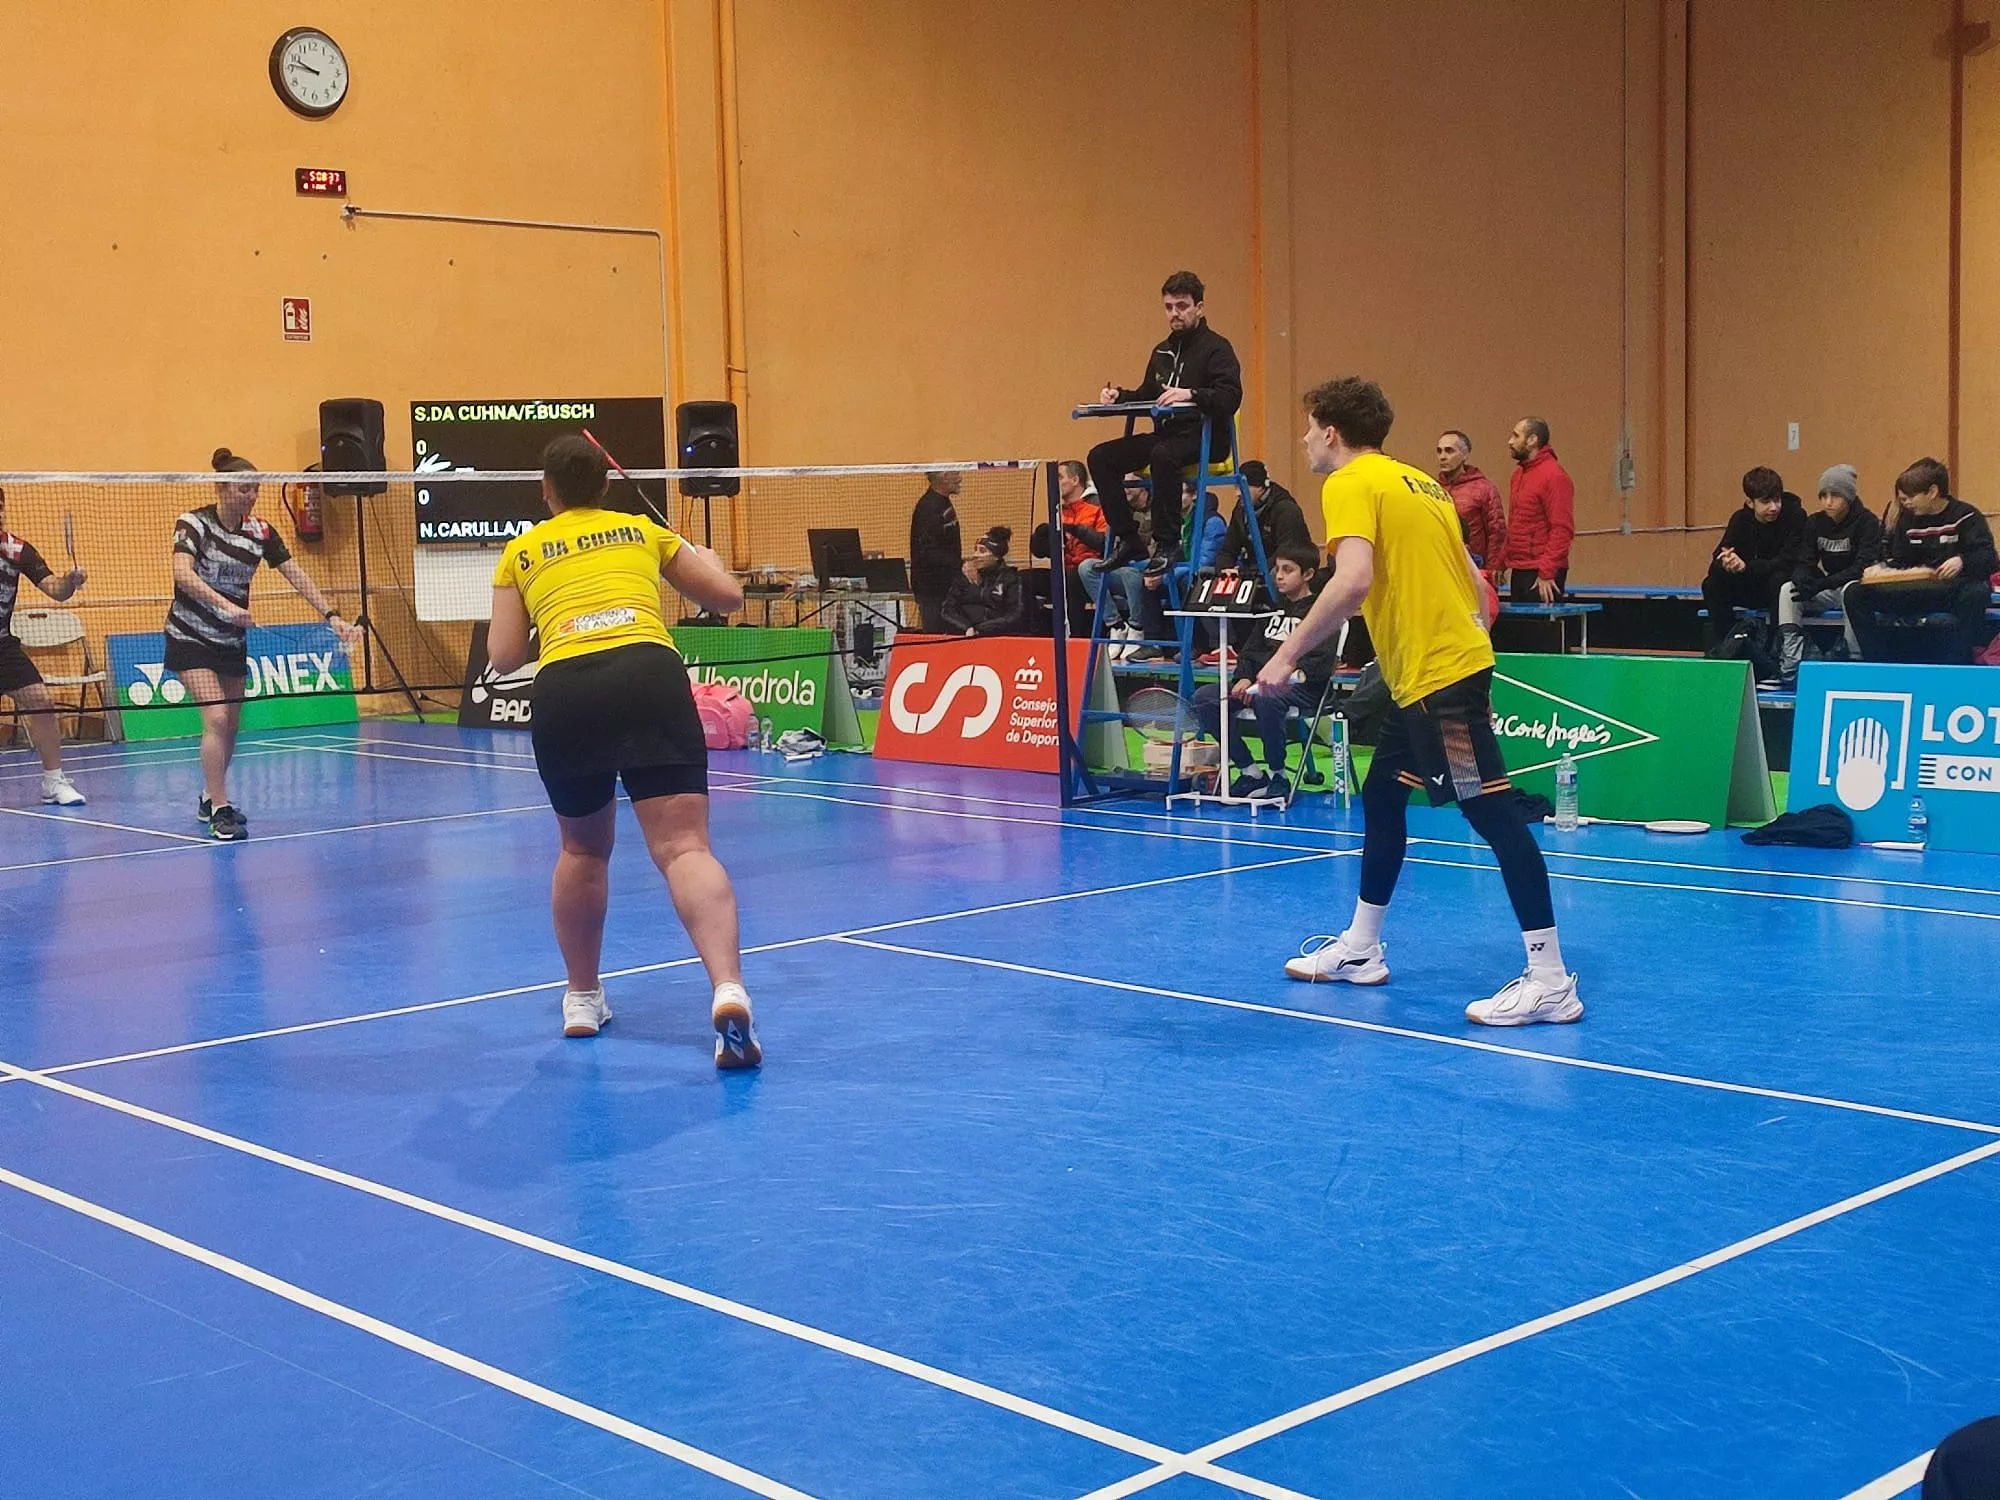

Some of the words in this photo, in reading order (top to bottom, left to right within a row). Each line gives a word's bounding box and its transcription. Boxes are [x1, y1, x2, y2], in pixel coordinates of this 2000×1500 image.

[414, 406, 455, 422] S.DA
[416, 440, 427, 455] 0
[418, 490, 430, 505] 0
[519, 549, 534, 571] S.
[541, 539, 569, 559] DA
[576, 526, 646, 551] CUNHA
[1198, 579, 1212, 603] 1
[1235, 579, 1253, 604] 0
[244, 652, 341, 698] ONEX
[1013, 696, 1057, 719] Consejo
[1010, 712, 1058, 730] Superior
[1006, 729, 1020, 742] de
[1504, 715, 1547, 739] Corte
[1546, 712, 1611, 749] Inglés
[1946, 765, 1992, 781] CON
